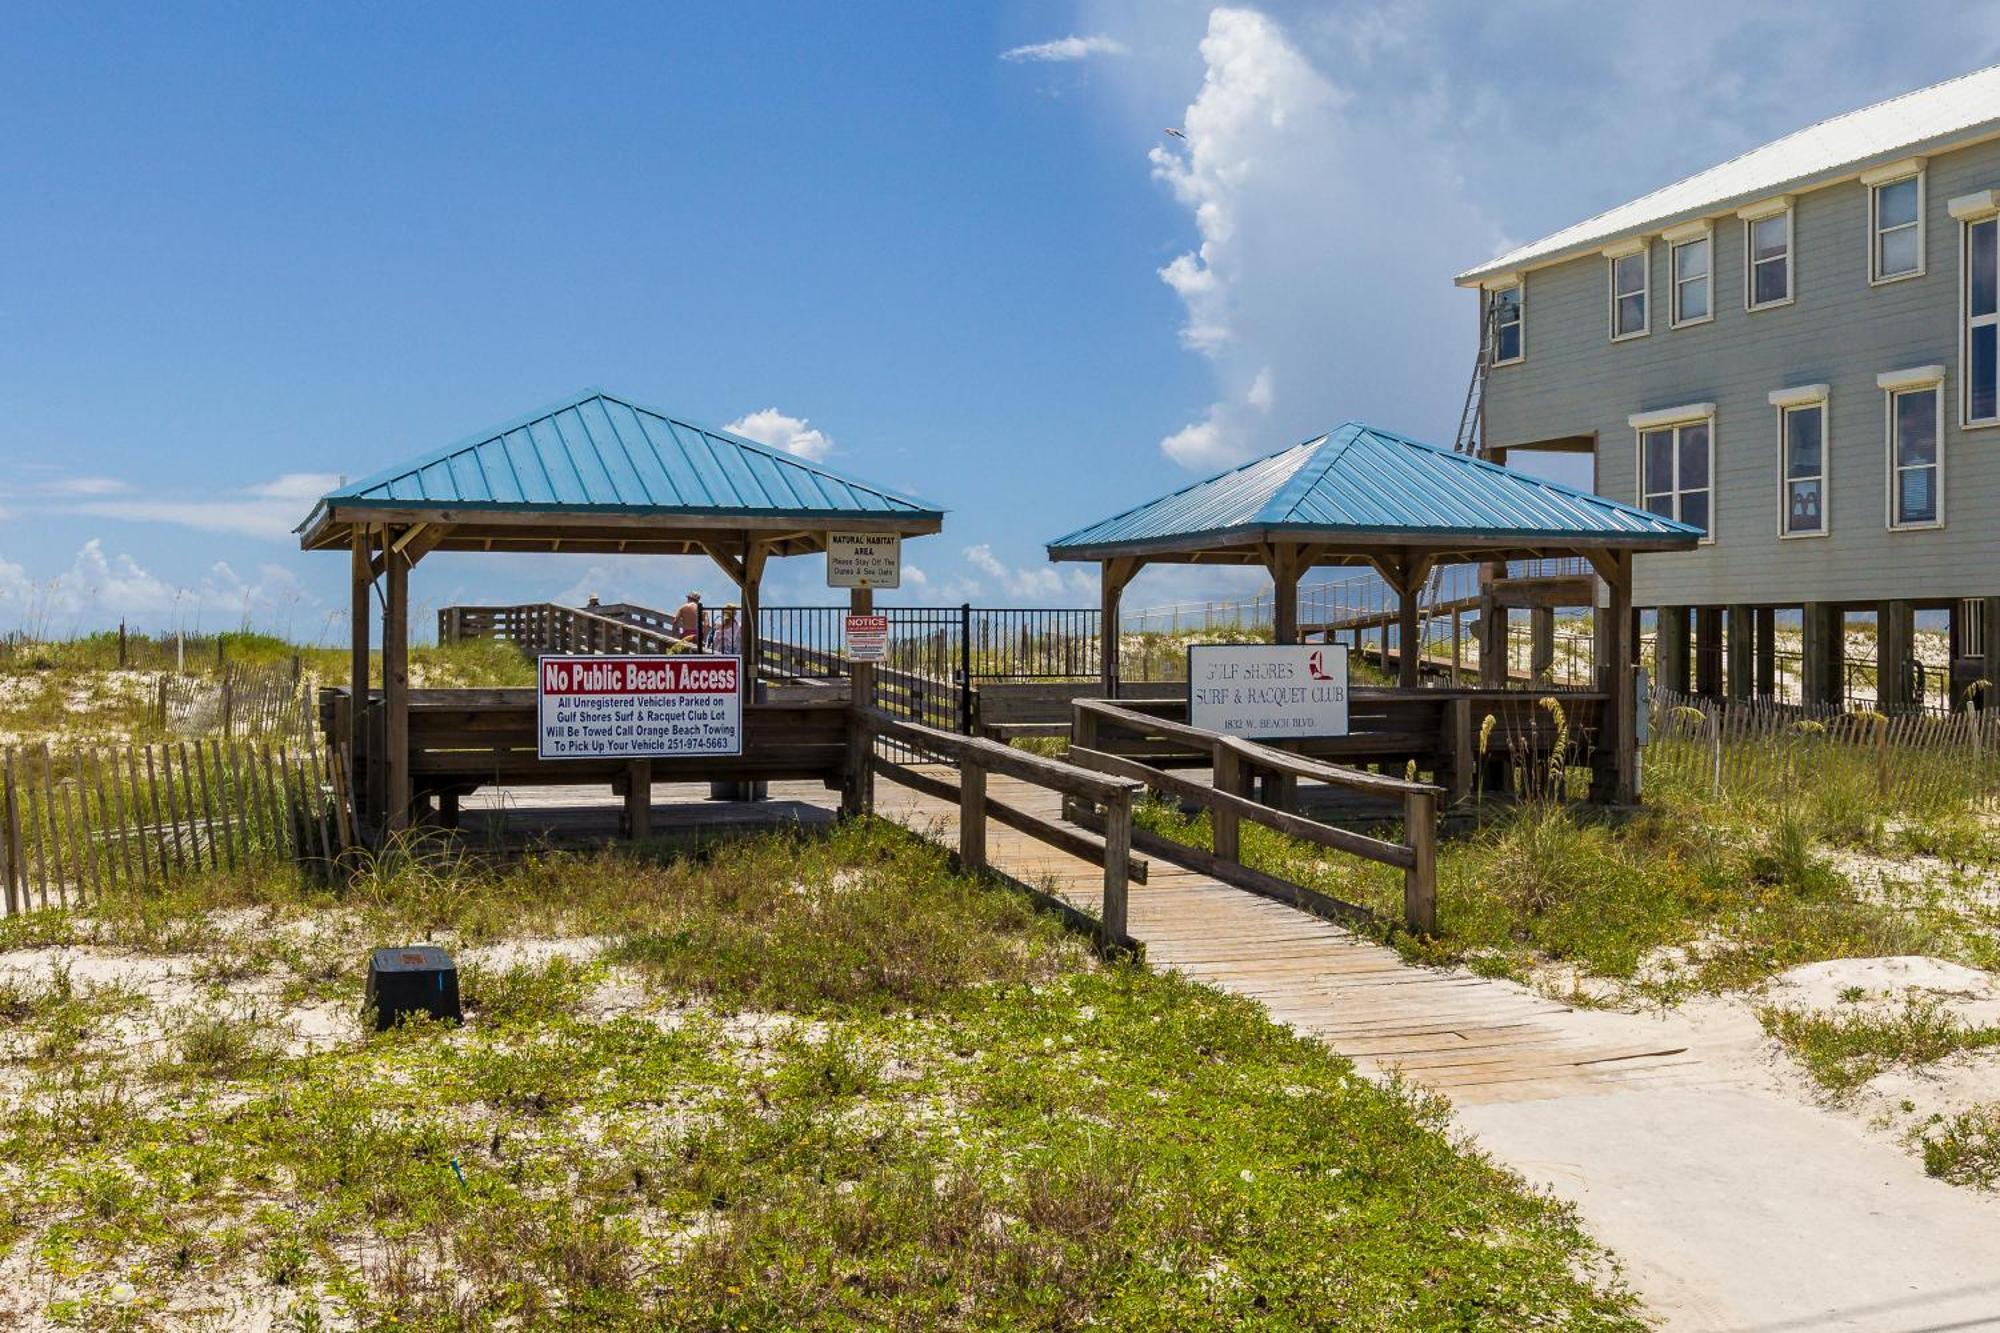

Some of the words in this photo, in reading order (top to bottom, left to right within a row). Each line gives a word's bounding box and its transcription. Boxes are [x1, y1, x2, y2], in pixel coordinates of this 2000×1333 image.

[833, 536, 863, 544] NATURAL
[866, 536, 895, 545] HABITAT
[848, 618, 885, 626] NOTICE
[546, 664, 568, 691] No
[573, 664, 622, 691] Public
[627, 664, 674, 690] Beach
[679, 664, 735, 689] Access
[1207, 664, 1239, 680] GLF
[1196, 689, 1229, 704] SURF
[1234, 689, 1242, 704] &
[1248, 688, 1306, 706] RACQUET
[1312, 687, 1344, 703] CLUB
[558, 698, 571, 708] All
[574, 697, 634, 710] Unregistered
[638, 697, 676, 707] Vehicles
[679, 697, 709, 707] Parked
[557, 712, 576, 722] Gulf
[580, 711, 612, 722] Shores
[615, 711, 634, 721] Surf
[637, 712, 644, 721] &
[647, 711, 685, 723] Racquet
[688, 711, 707, 721] Club
[710, 711, 725, 720] Lot
[1224, 719, 1243, 729] 1832
[1246, 719, 1256, 729] W.
[1260, 718, 1289, 728] BEACH
[546, 726, 564, 737] Will
[568, 726, 579, 736] Be
[582, 726, 612, 736] Towed
[616, 726, 634, 736] Call
[637, 725, 669, 737] Orange
[673, 725, 700, 735] Beach
[704, 725, 735, 736] Towing
[555, 741, 566, 752] To
[569, 741, 589, 751] Pick
[592, 741, 604, 753] Up
[608, 740, 628, 750] Your
[631, 740, 664, 750] Vehicle
[668, 738, 728, 749] 251-974-5663
